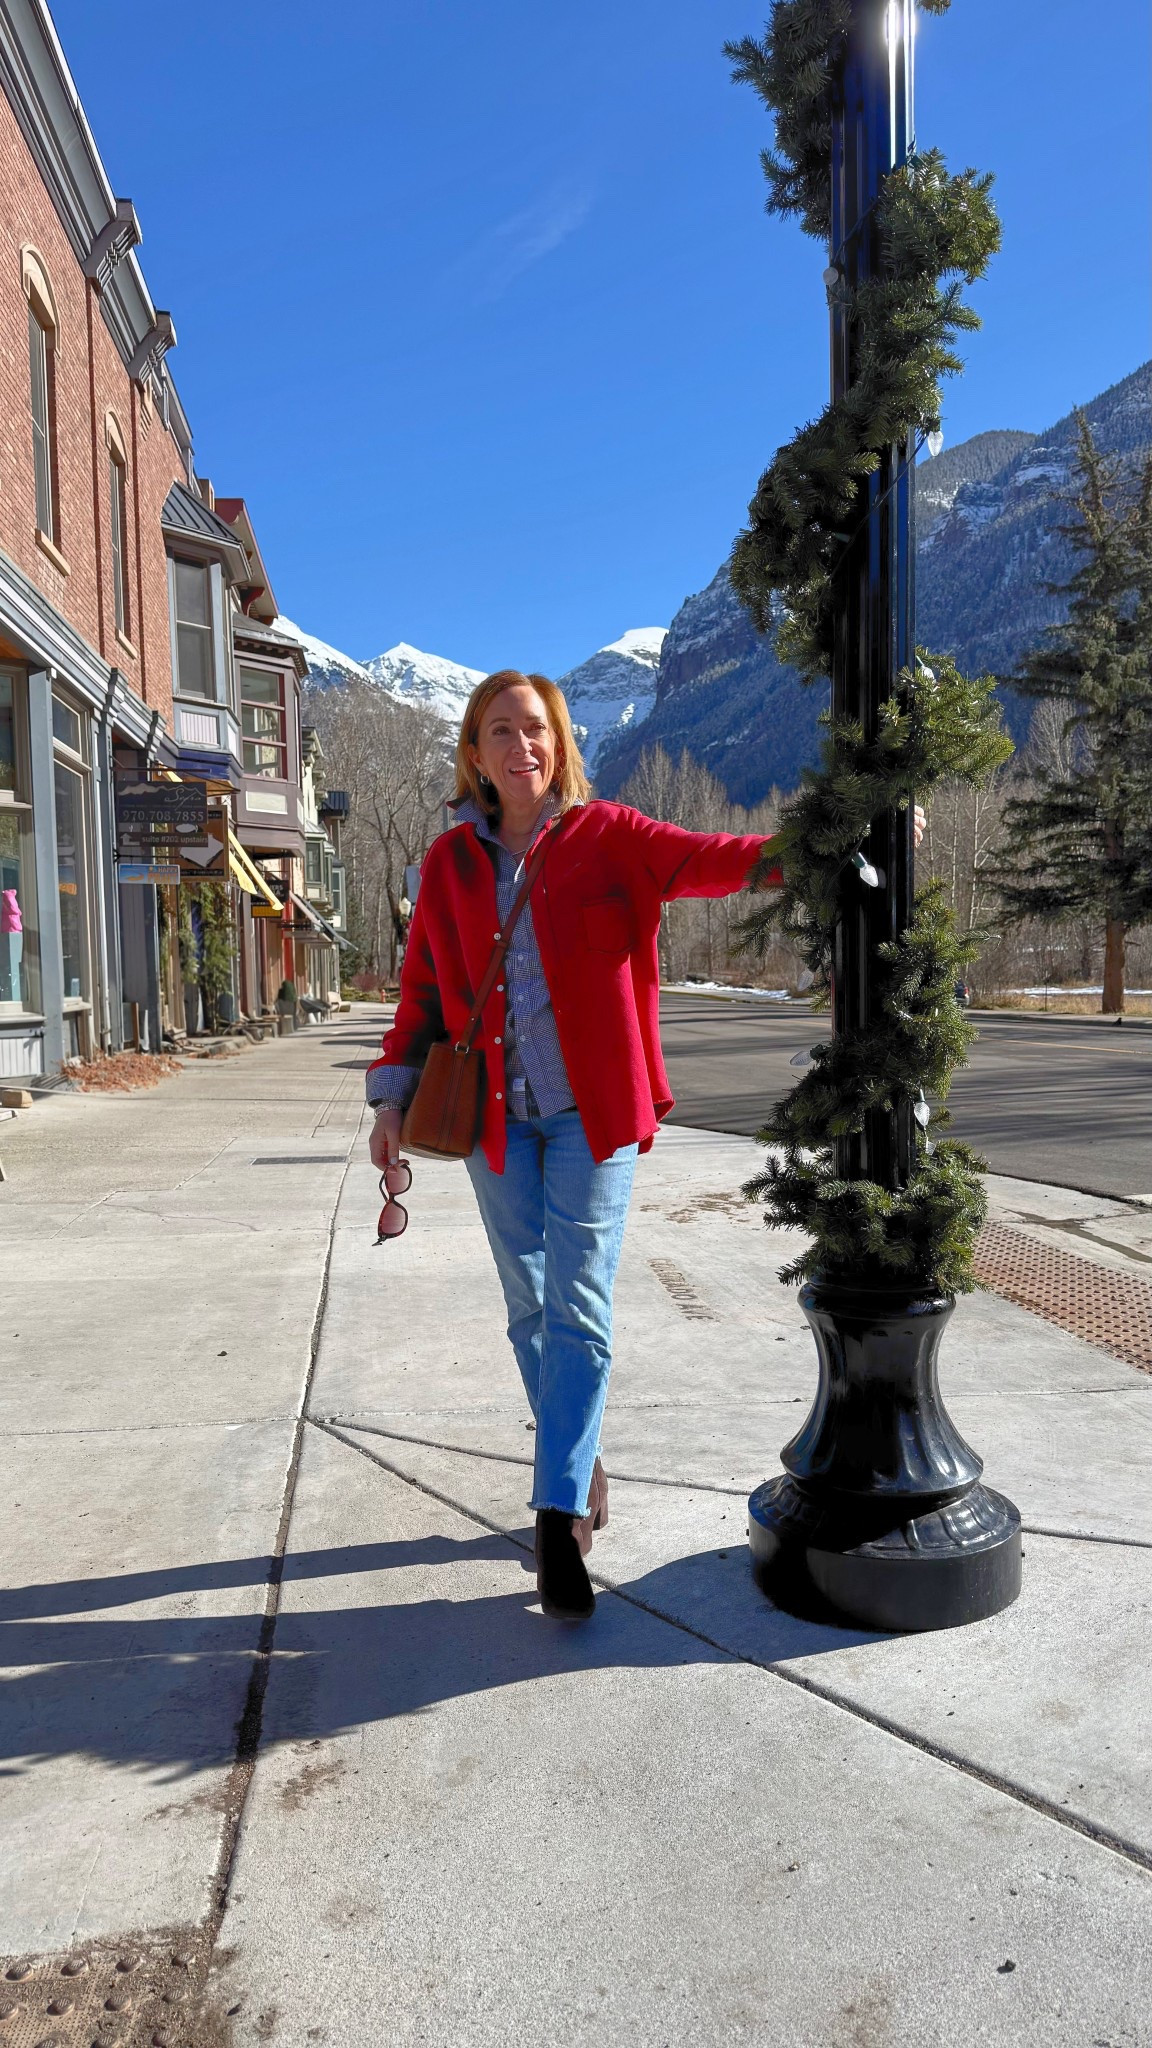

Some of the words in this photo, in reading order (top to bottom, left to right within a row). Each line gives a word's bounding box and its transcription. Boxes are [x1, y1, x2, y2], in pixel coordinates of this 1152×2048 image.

[122, 810, 204, 822] 970.708.7855
[142, 835, 160, 843] suite
[180, 835, 208, 844] upstairs
